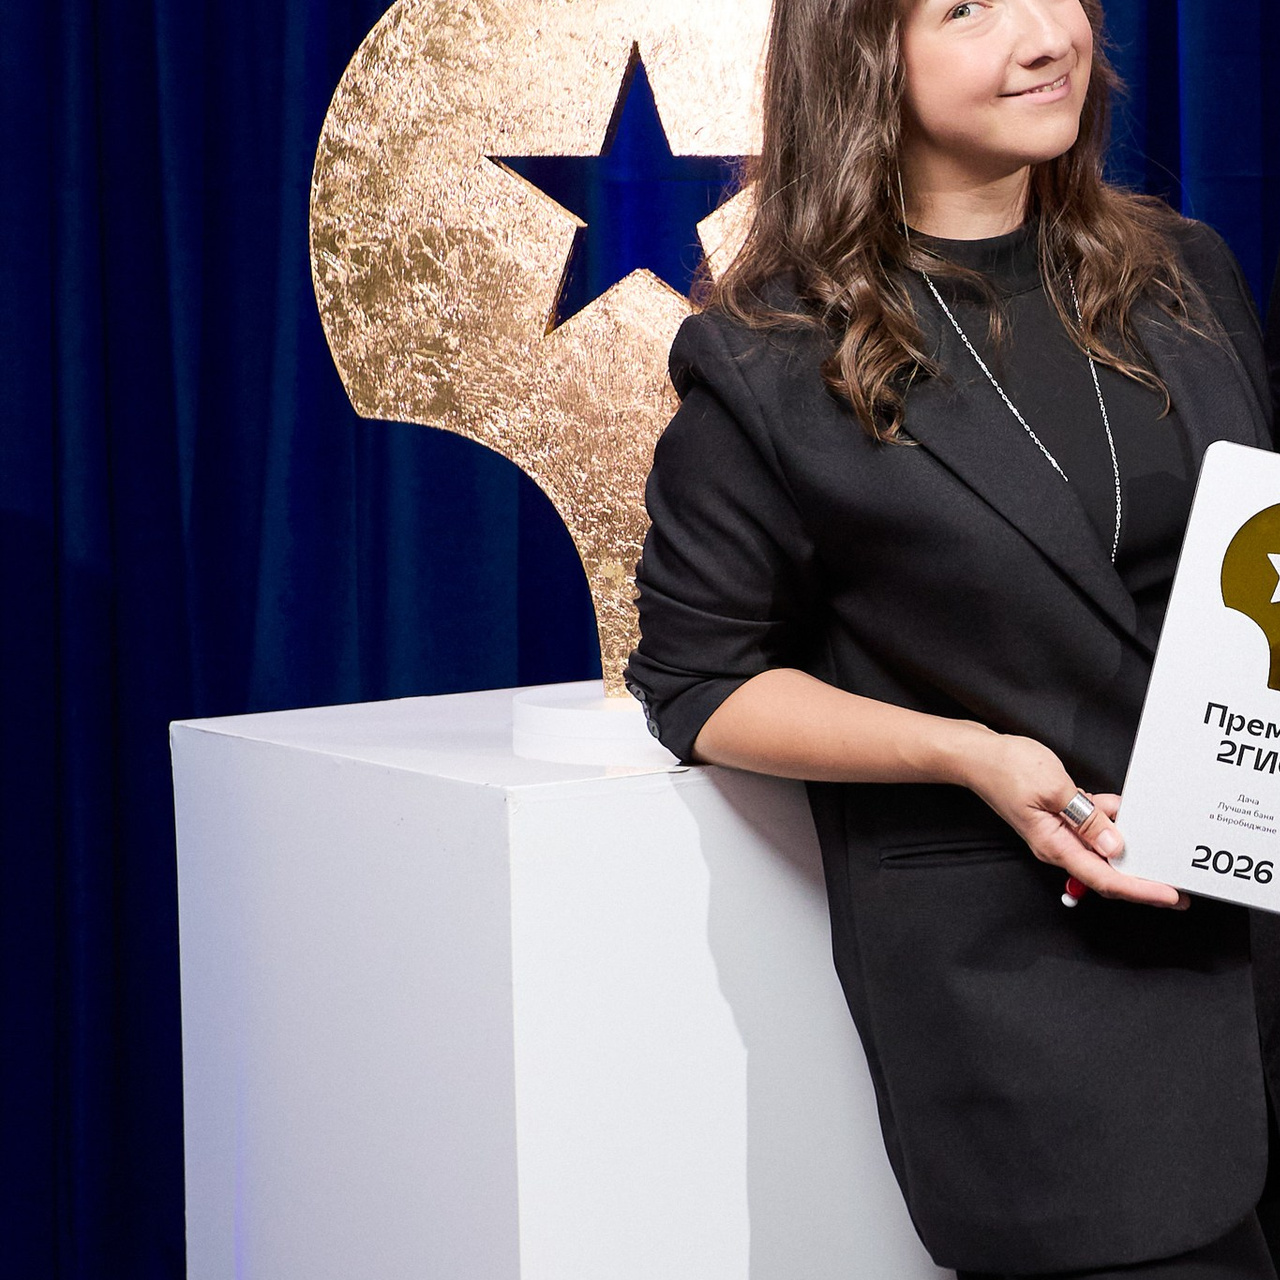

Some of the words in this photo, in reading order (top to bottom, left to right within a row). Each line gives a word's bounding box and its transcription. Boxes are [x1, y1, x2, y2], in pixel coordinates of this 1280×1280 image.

[1237, 793, 1260, 806] Дача
[1217, 801, 1252, 816] Лучшая
[1253, 809, 1275, 821] баня
[1216, 813, 1278, 835] Биробиджане
[1190, 844, 1275, 885] 2026
